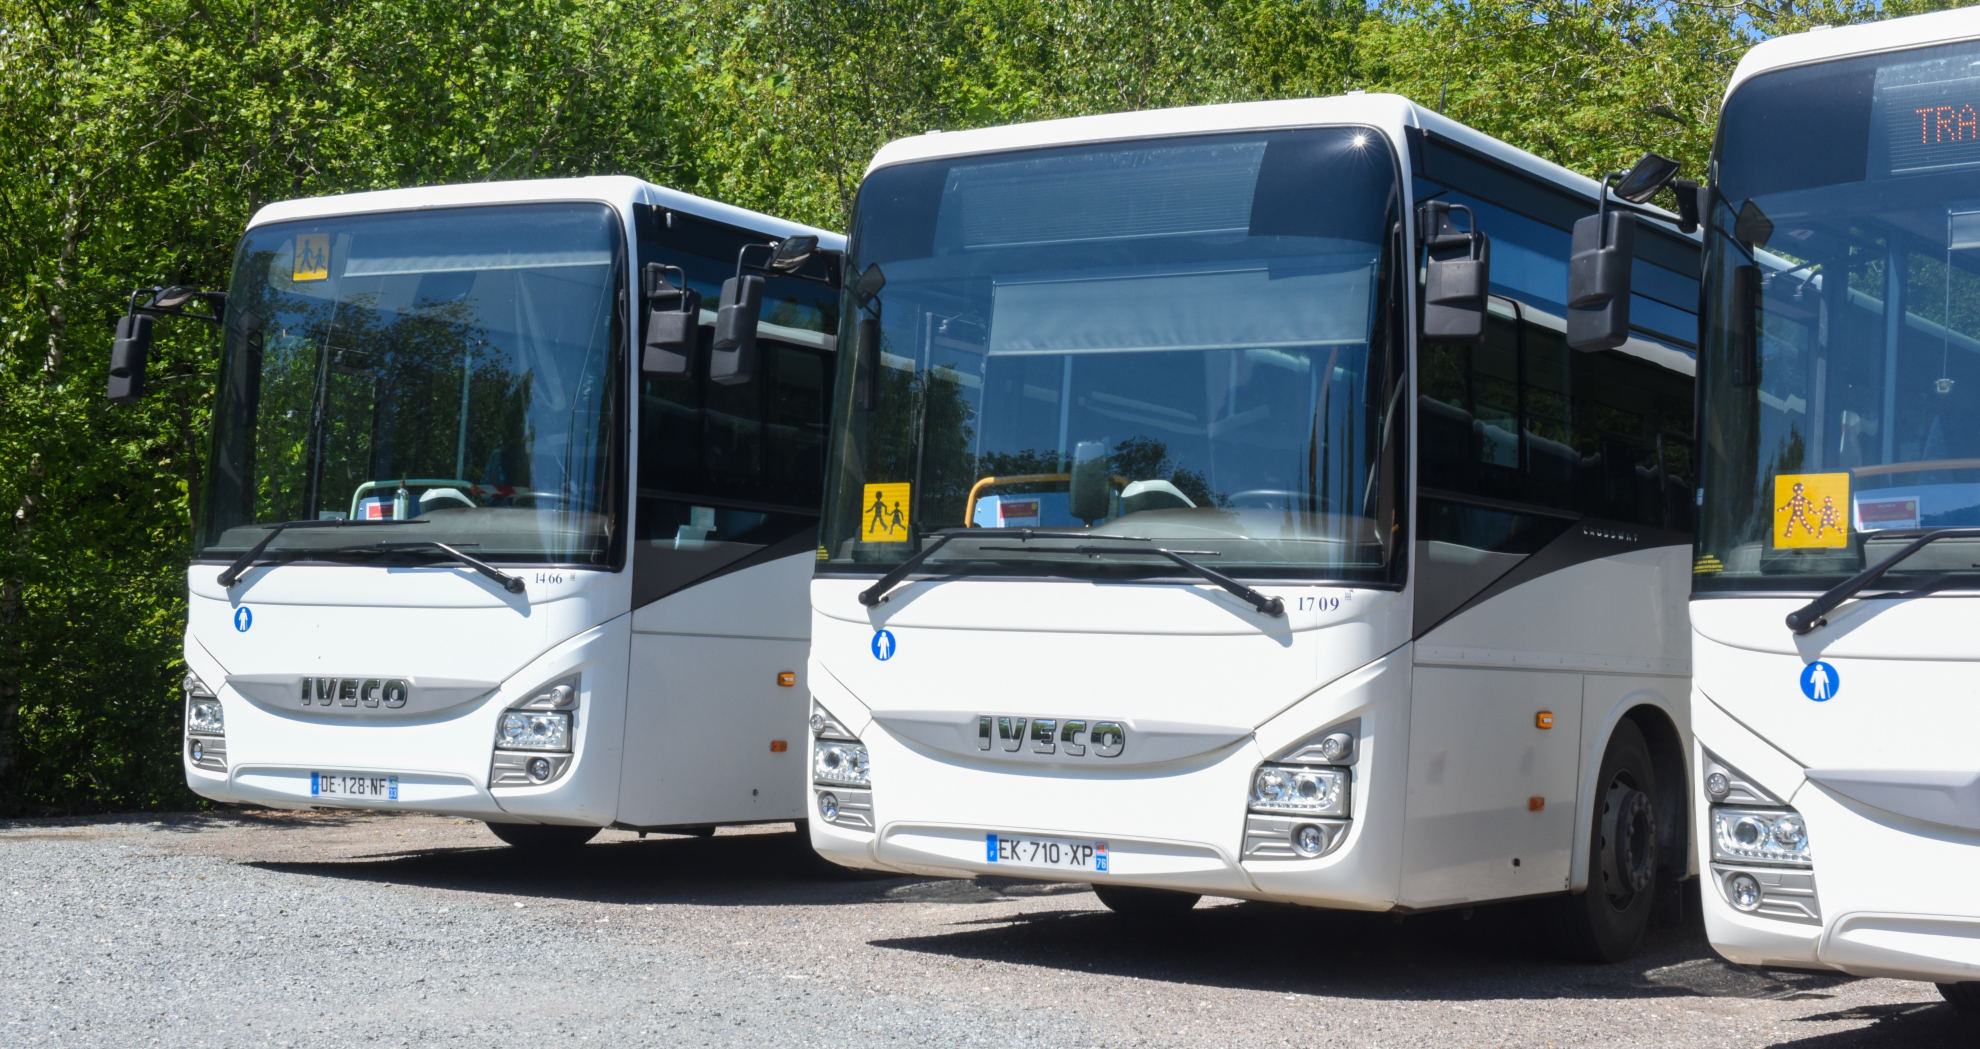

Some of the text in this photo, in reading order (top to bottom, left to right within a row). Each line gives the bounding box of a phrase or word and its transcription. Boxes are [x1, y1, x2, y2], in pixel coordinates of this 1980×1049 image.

[1915, 104, 1976, 144] TRA
[535, 572, 563, 584] 1466
[1297, 596, 1339, 611] 1709
[300, 677, 408, 709] IVECO
[979, 715, 1126, 758] IVECO
[1096, 857, 1107, 869] 76
